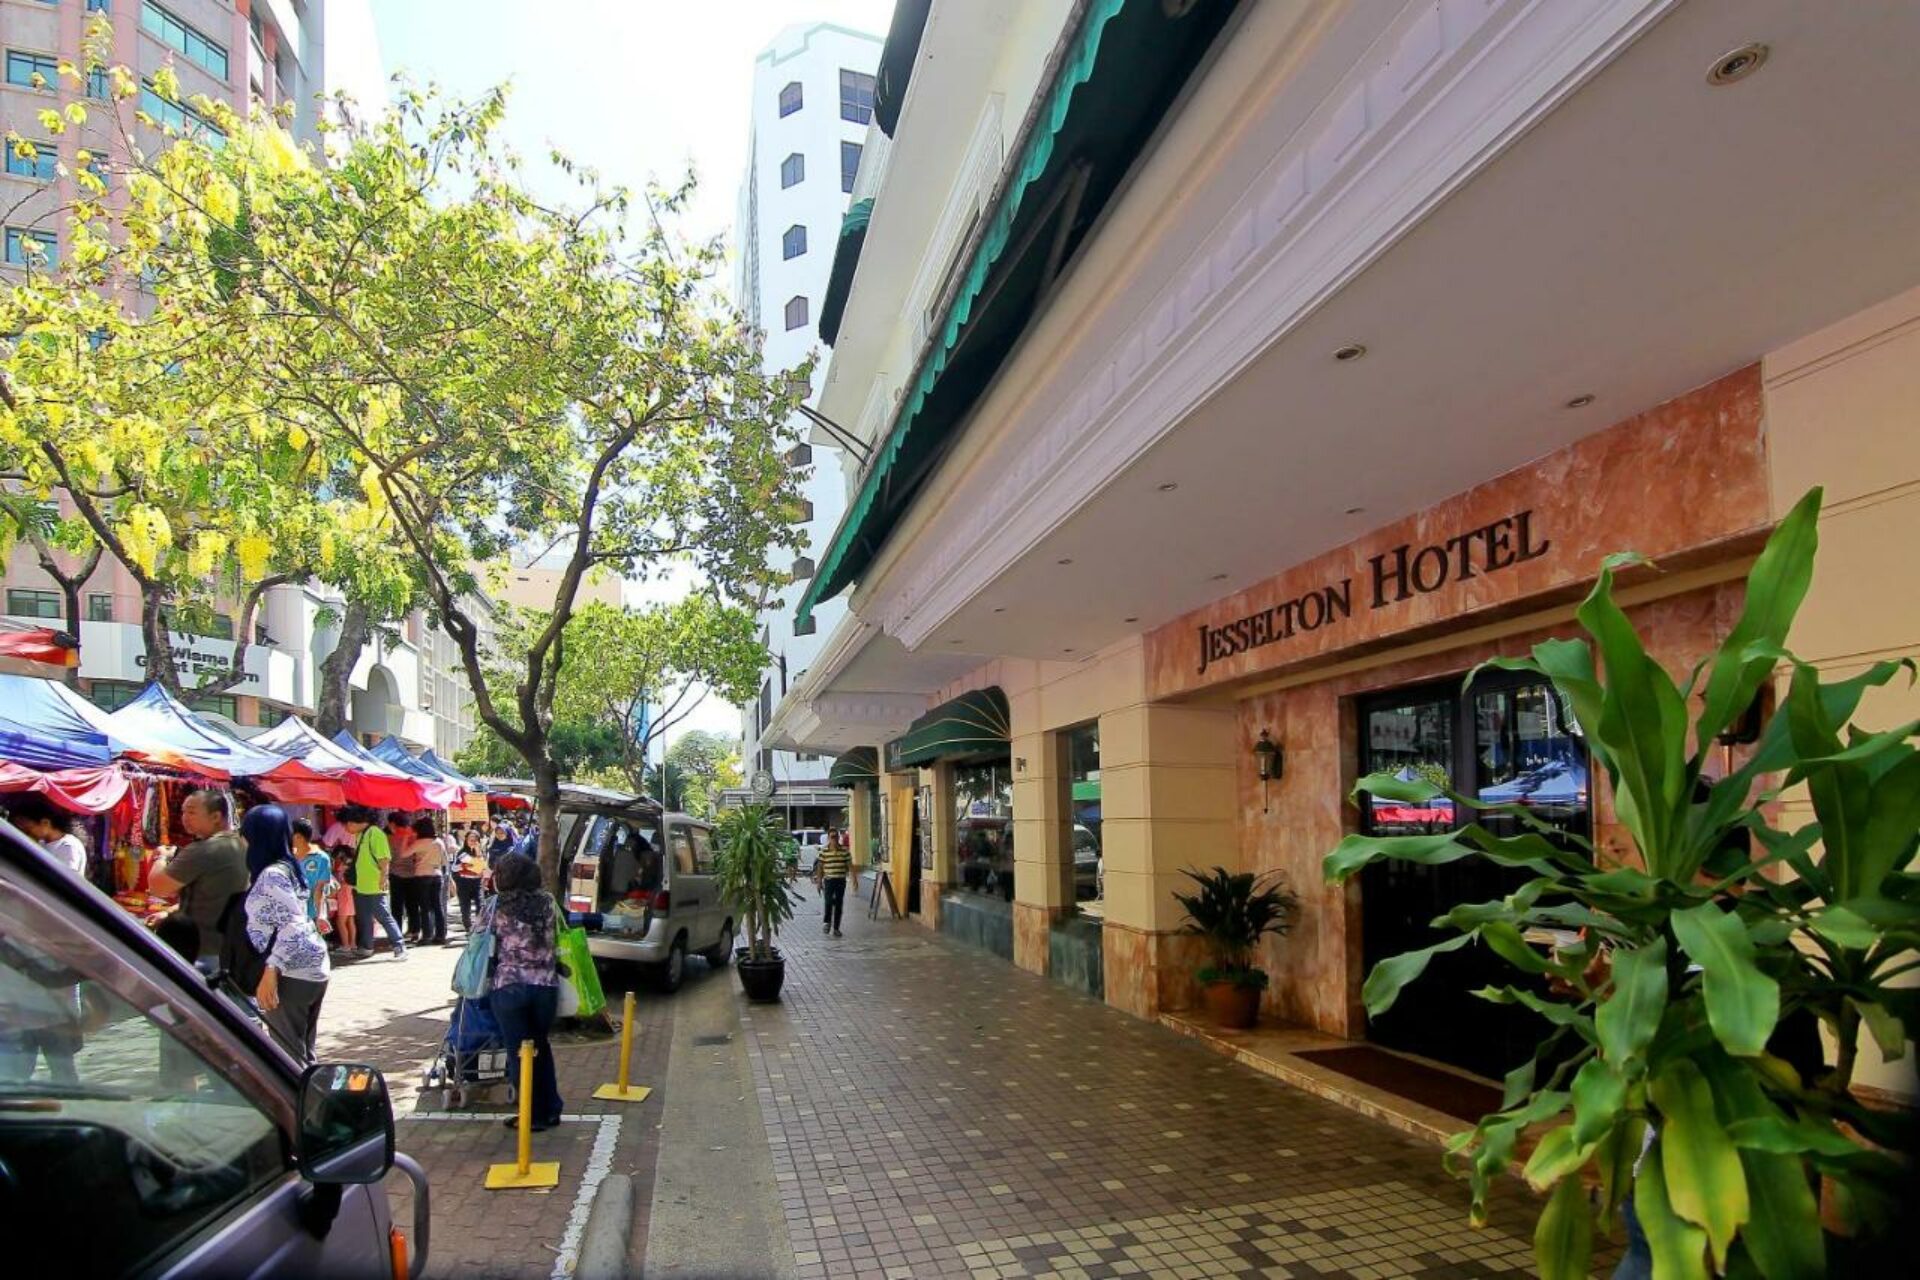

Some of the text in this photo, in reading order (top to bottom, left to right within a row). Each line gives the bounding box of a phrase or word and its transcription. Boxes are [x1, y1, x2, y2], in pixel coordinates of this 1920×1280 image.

[1197, 510, 1550, 675] JESSELTON HOTEL
[135, 655, 260, 683] Gat Earn
[169, 646, 229, 666] Wisma
